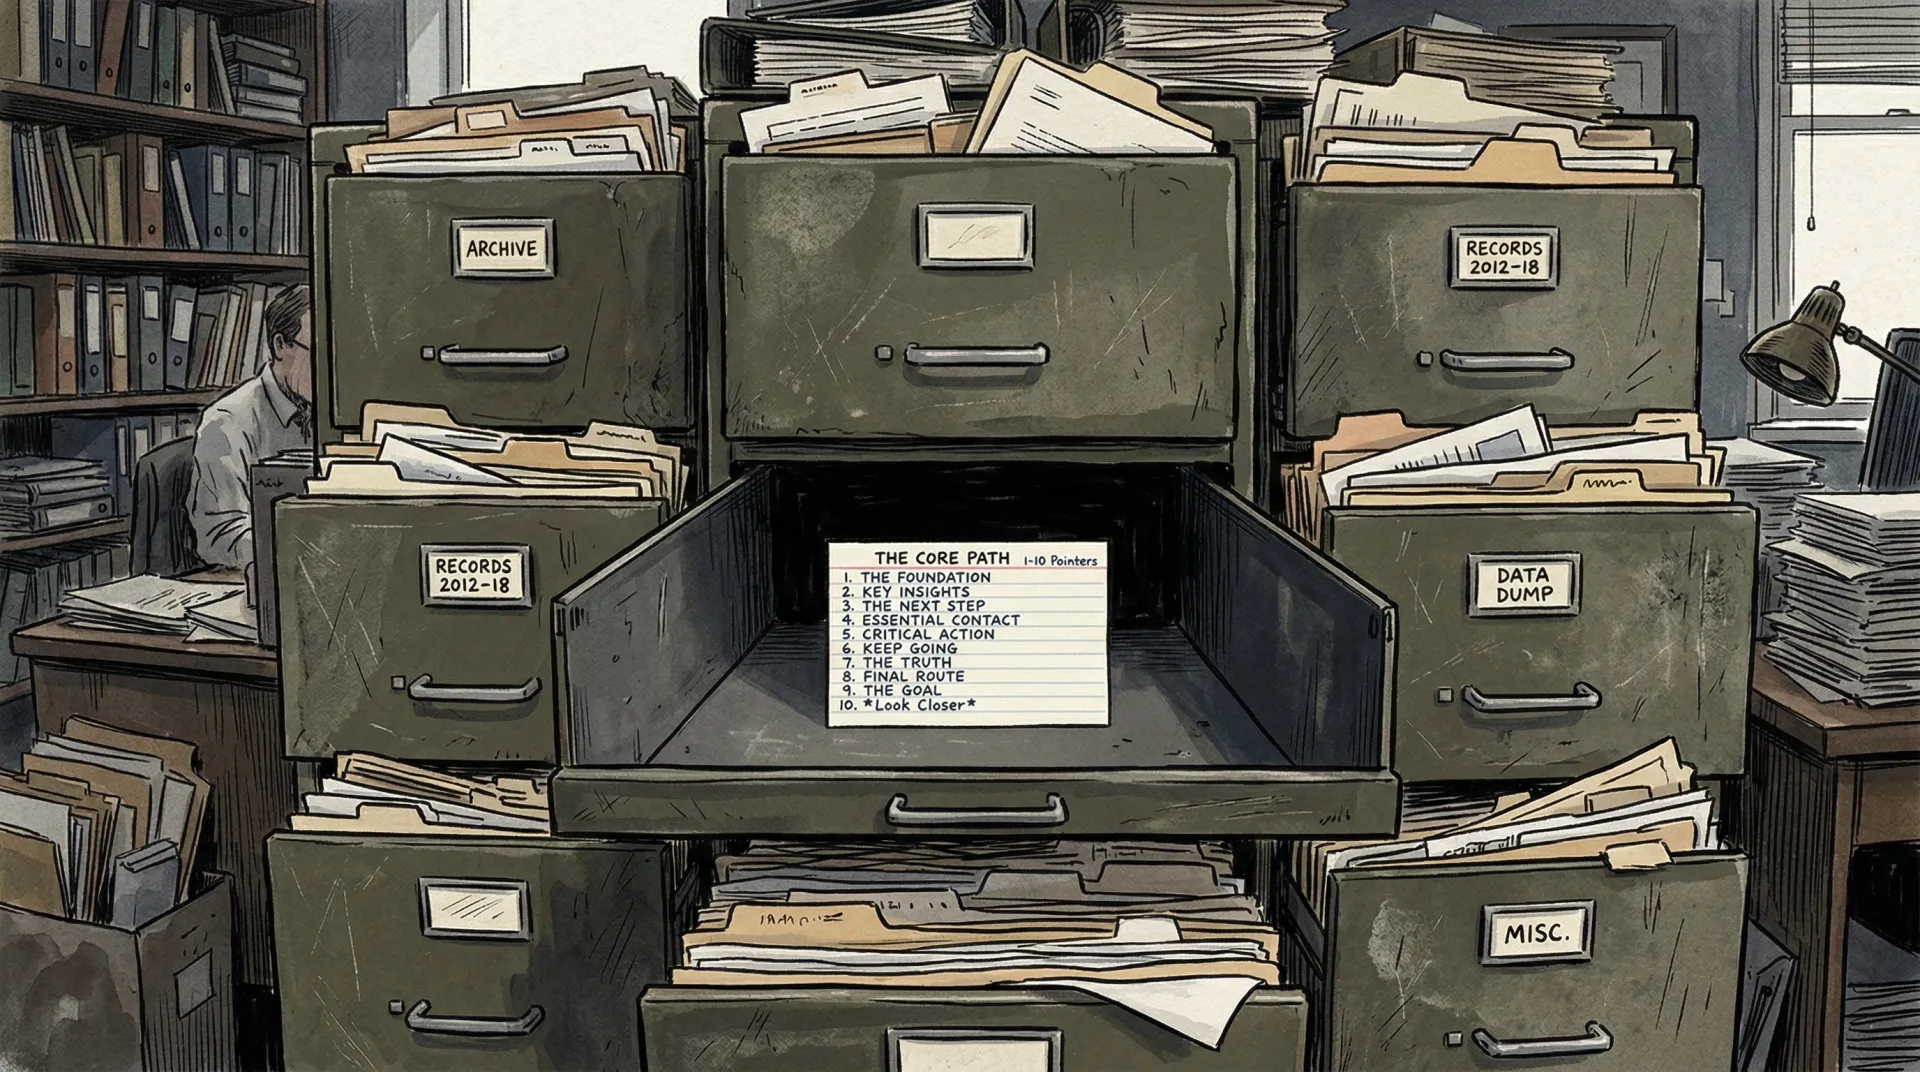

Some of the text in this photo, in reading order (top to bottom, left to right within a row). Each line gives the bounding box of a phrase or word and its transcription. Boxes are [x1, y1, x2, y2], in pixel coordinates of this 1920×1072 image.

[466, 239, 538, 258] ARCHIVE
[1466, 240, 1543, 257] RECORDS
[1469, 259, 1540, 276] 2012-18
[874, 550, 1010, 565] THE CORE PATH
[1024, 554, 1098, 567] 1-10 Pointers
[436, 558, 512, 575] RECORDS
[844, 571, 991, 584] 1. THE FOUNDATION
[1497, 566, 1550, 584] DATA
[439, 576, 510, 594] 2012-18
[842, 585, 970, 598] 2. KEY INSIGHTS
[1496, 585, 1554, 604] DUMP
[842, 599, 986, 613] 3. THE NEXT STEP
[841, 614, 1021, 627] 4. ESSENTIAL CONTACT
[842, 628, 995, 641] 5. CRITICAL ACTION
[842, 642, 958, 655] 6. KEEP GOING
[842, 656, 952, 669] 7. THE TRUTH
[842, 670, 965, 683] 8. FINAL ROUTE
[842, 684, 942, 697] 9. THE GOAL
[839, 699, 858, 711] 10.
[1504, 923, 1570, 945] MISC.
